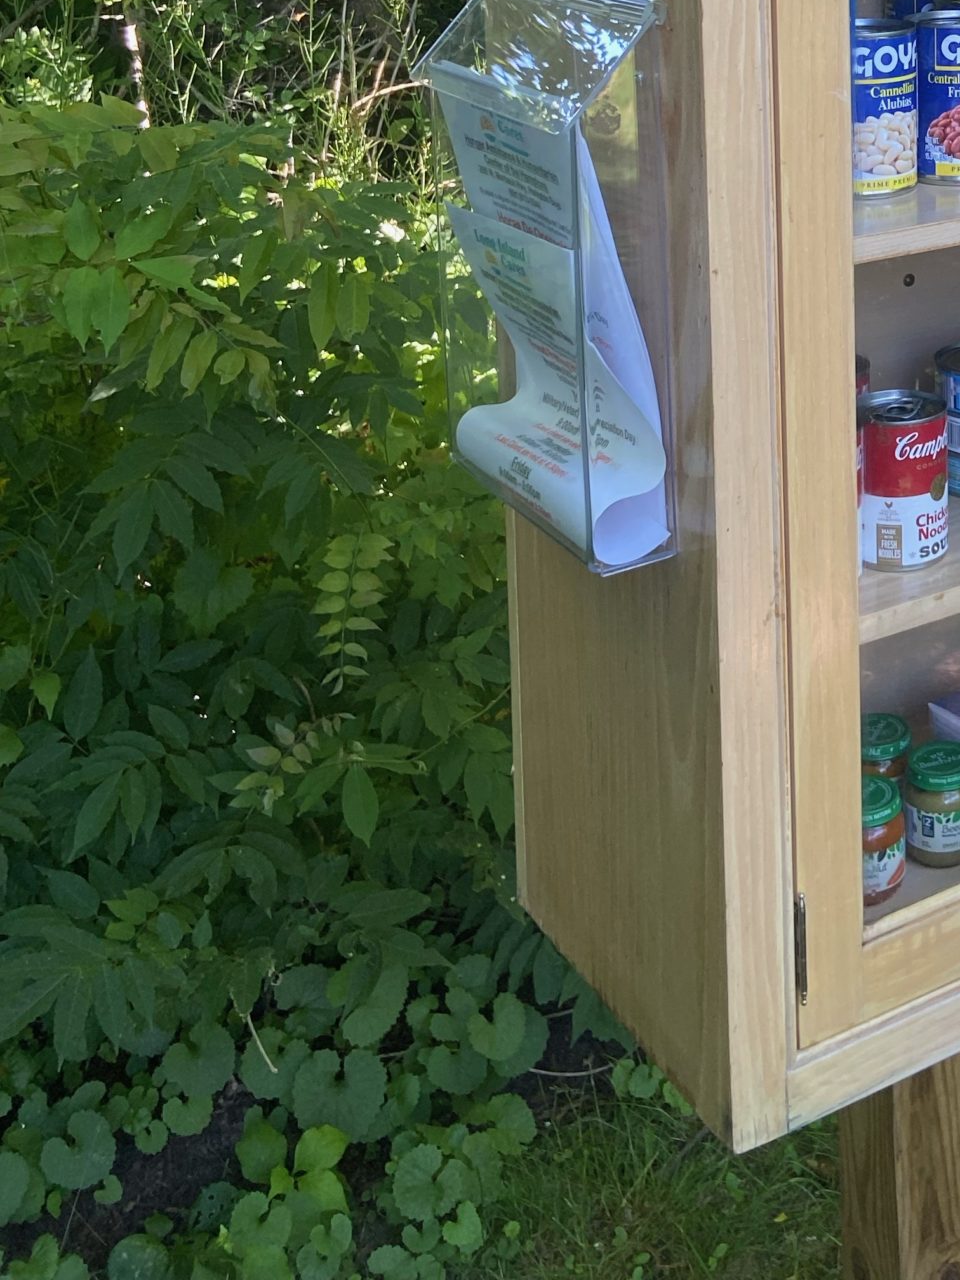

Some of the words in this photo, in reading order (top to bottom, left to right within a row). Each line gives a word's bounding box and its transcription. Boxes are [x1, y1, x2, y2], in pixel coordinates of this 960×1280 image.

[927, 72, 960, 84] Central
[879, 96, 913, 112] Alubias
[924, 817, 932, 826] 2
